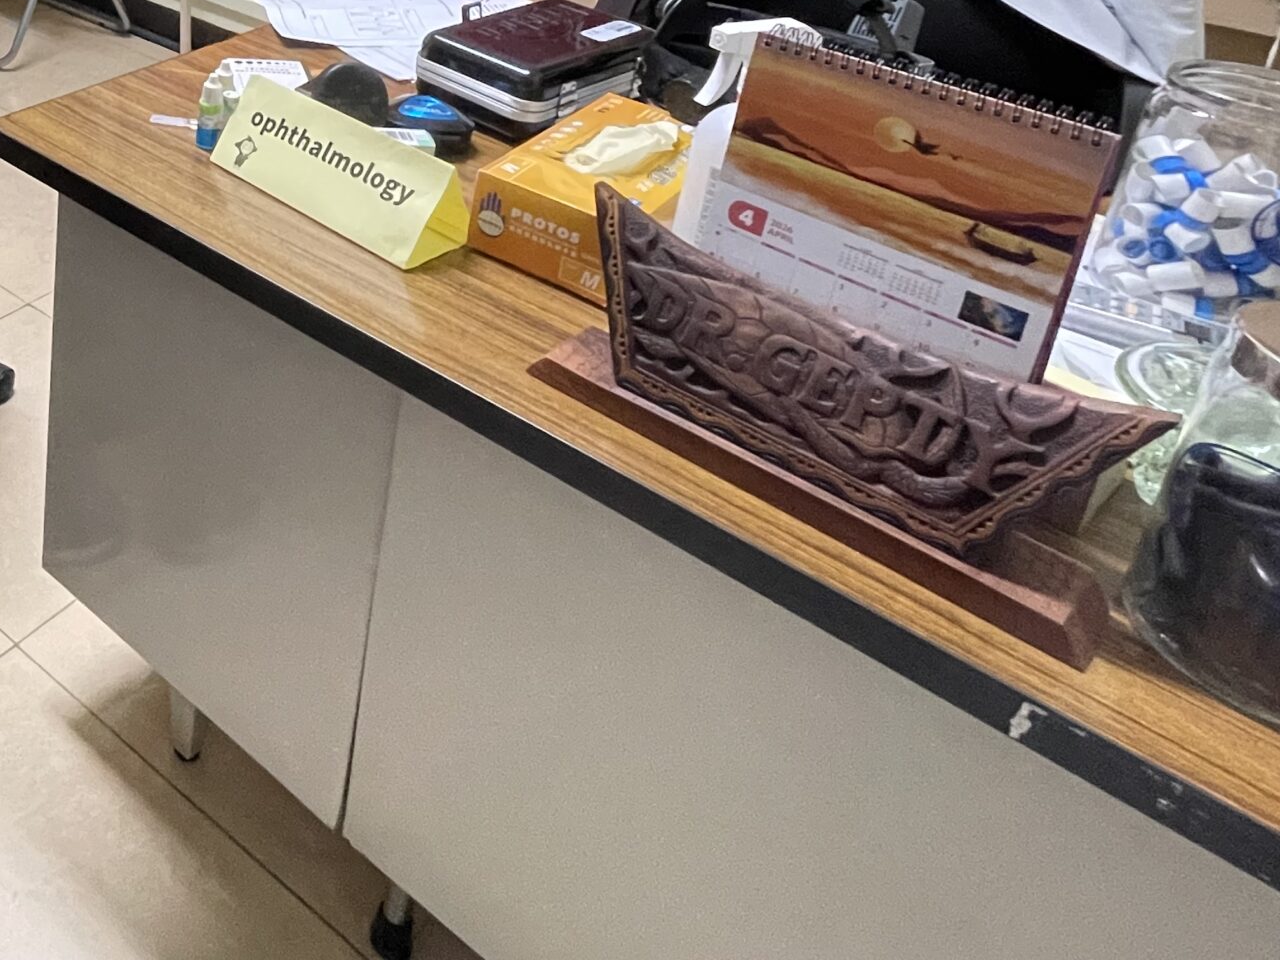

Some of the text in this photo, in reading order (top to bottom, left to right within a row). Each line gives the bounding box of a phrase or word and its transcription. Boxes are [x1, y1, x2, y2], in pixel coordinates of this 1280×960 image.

[250, 111, 416, 207] ophthalmology
[510, 207, 581, 244] PROTOS
[738, 208, 755, 227] 4
[580, 271, 600, 290] M
